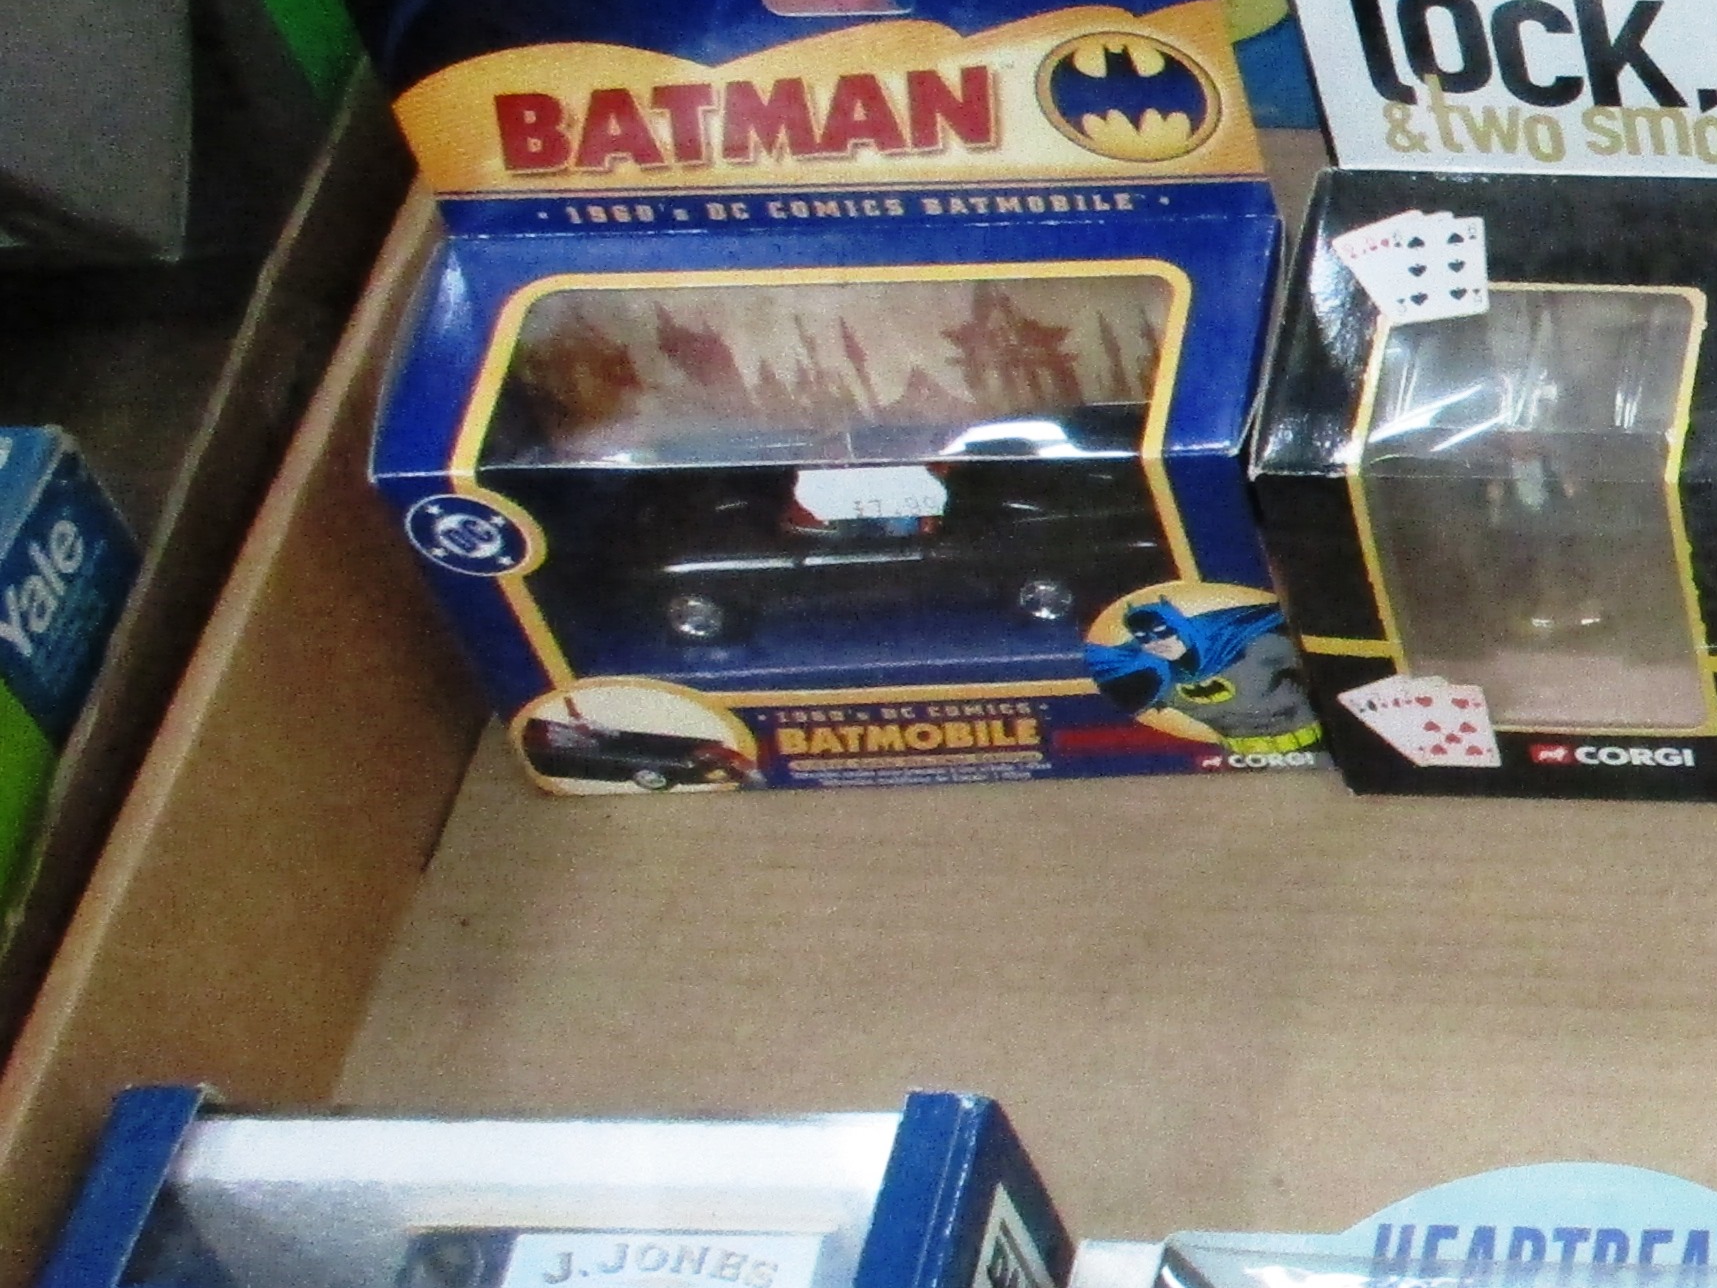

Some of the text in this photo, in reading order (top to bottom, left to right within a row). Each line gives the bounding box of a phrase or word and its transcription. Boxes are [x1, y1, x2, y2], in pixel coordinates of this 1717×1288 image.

[494, 65, 1000, 178] BATMAN
[1427, 74, 1566, 163] two
[767, 197, 904, 220] COMICS
[922, 192, 1136, 218] BATMOBILE
[776, 717, 1042, 756] BATMOBILE
[1228, 751, 1315, 769] CORGI
[1574, 746, 1695, 767] CORGI
